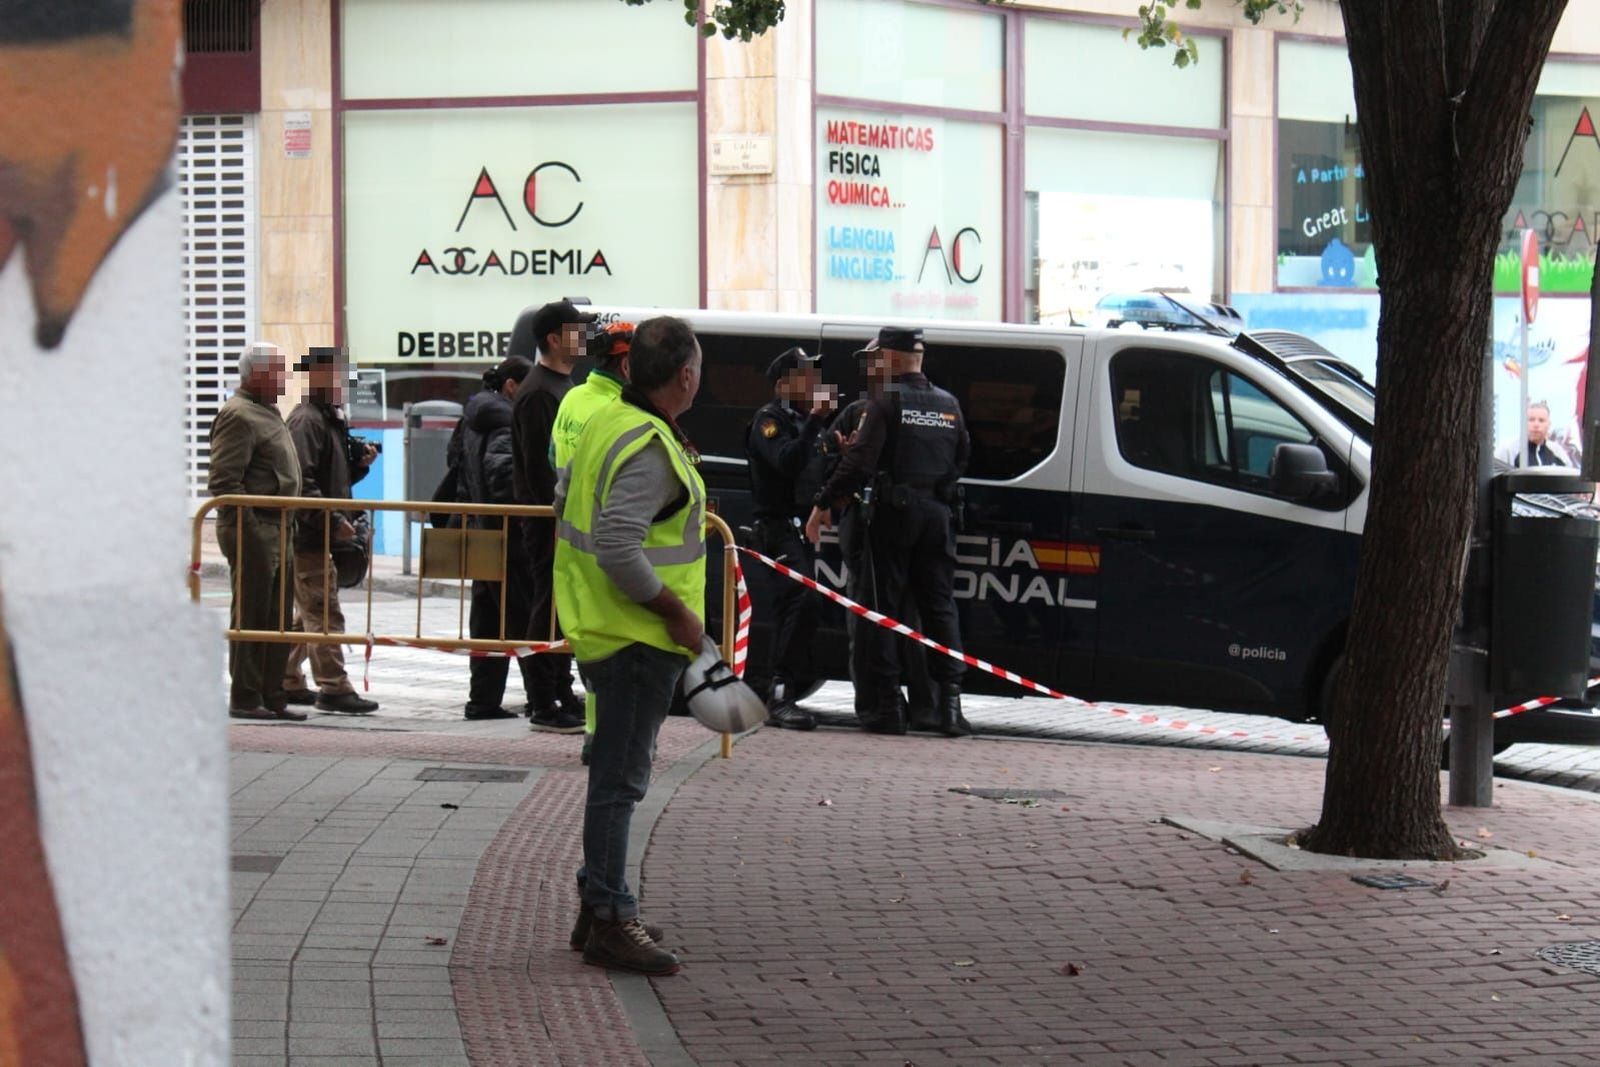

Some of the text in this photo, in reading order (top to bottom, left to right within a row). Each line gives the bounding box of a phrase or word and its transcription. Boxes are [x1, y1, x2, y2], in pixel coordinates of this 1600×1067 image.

[829, 146, 880, 177] FÍSICA
[455, 160, 584, 232] AC
[1303, 206, 1348, 238] Great
[830, 226, 895, 253] LENGUA
[411, 247, 612, 276] ACCADEMIA
[918, 225, 983, 285] AC
[902, 410, 944, 420] POLICIA
[902, 417, 955, 429] NACIONAL
[1228, 643, 1287, 661] @policia
